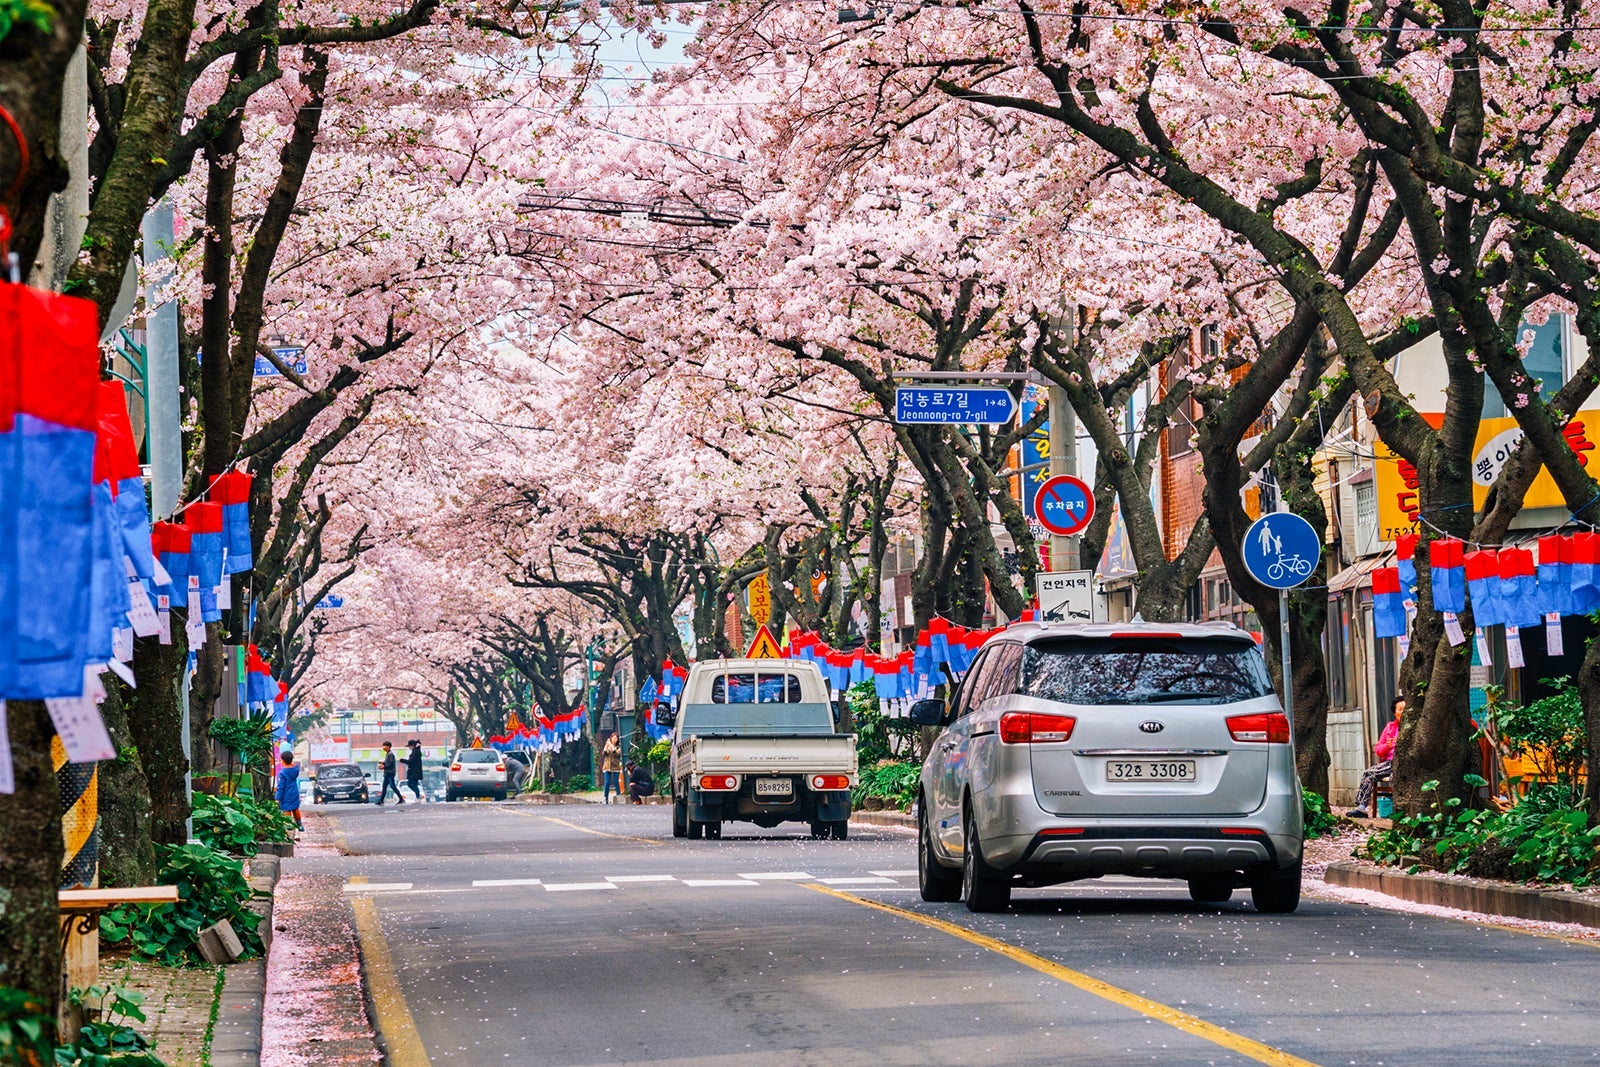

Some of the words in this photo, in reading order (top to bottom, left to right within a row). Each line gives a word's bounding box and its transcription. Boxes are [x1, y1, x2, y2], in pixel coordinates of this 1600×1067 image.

[900, 392, 968, 408] 전농로7길
[900, 410, 961, 421] Jeonnong-ro
[965, 410, 988, 421] 7-gil
[1045, 501, 1085, 511] 주차금지
[1042, 578, 1087, 590] 견인지역
[752, 573, 769, 624] 산보살
[1142, 723, 1161, 731] KIA
[1115, 763, 1143, 777] 32호
[1150, 763, 1187, 777] 3308
